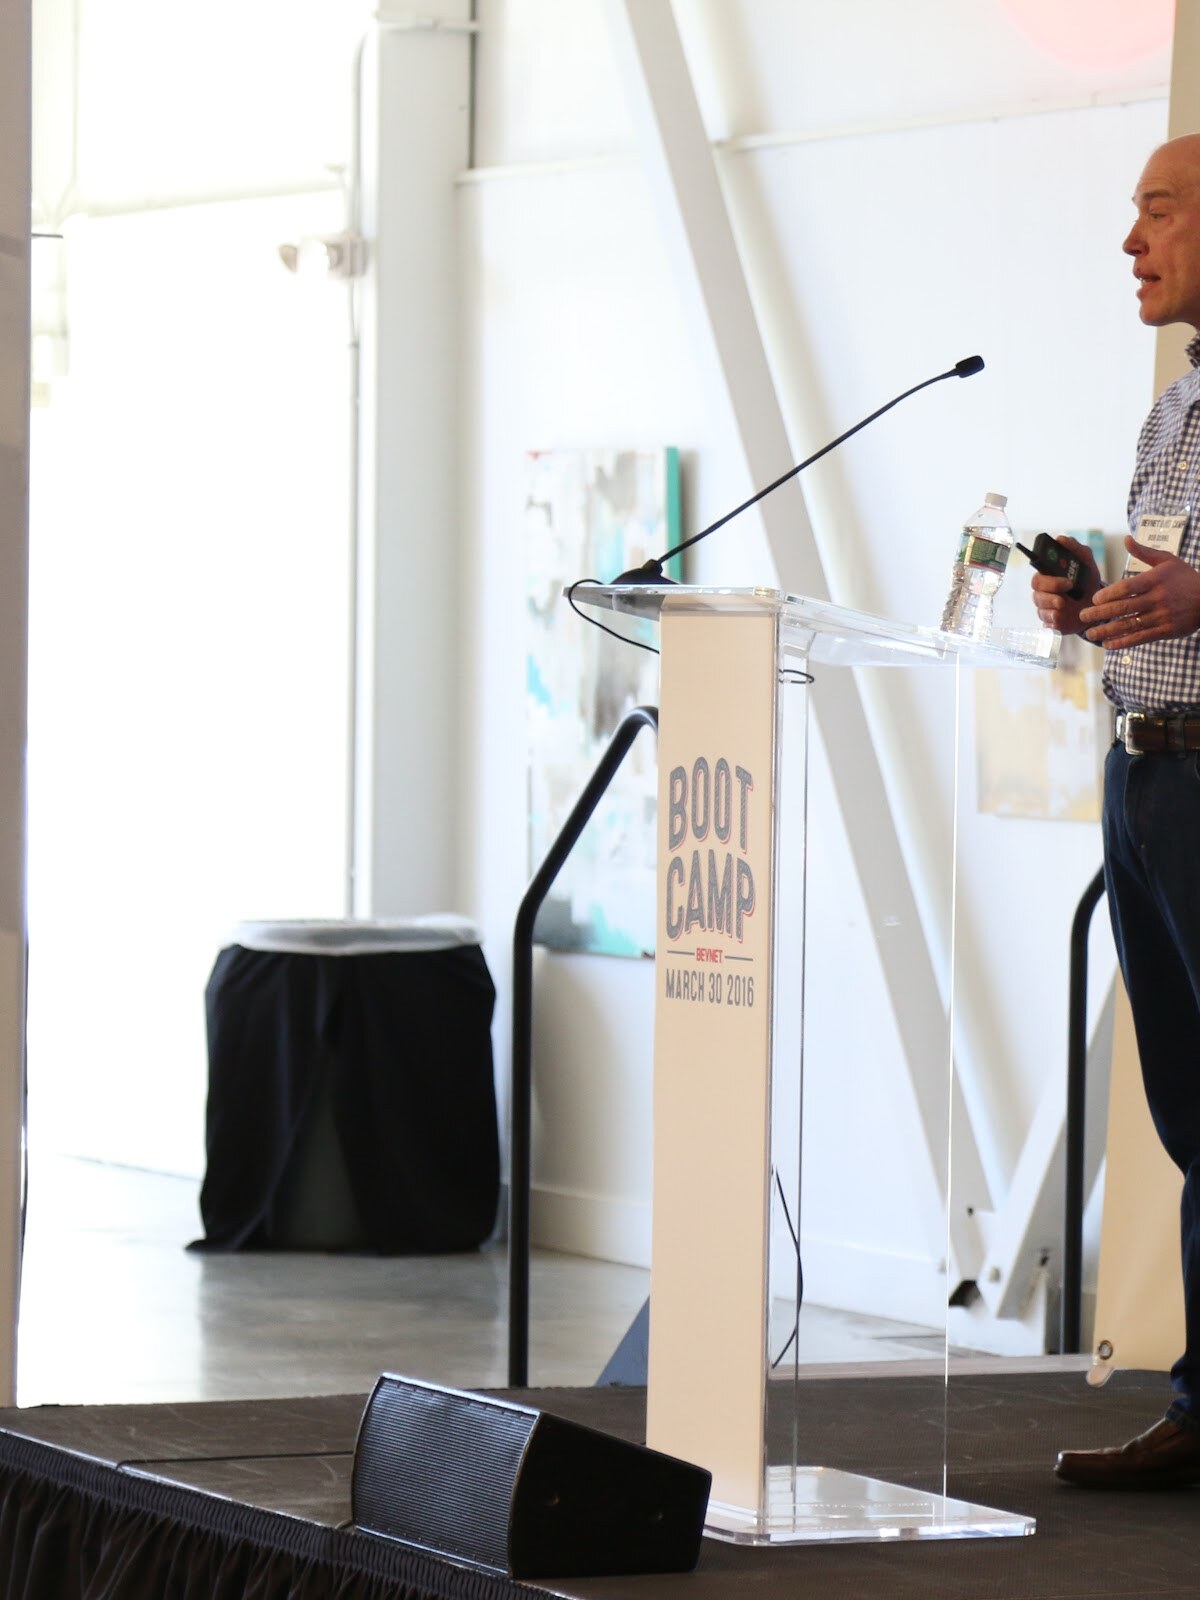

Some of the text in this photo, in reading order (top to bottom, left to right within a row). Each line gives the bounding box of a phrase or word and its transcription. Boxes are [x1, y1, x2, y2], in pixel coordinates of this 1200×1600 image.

[668, 756, 753, 854] BOOT
[666, 849, 755, 943] CAMP
[666, 968, 754, 1007] MARCH 30 2016
